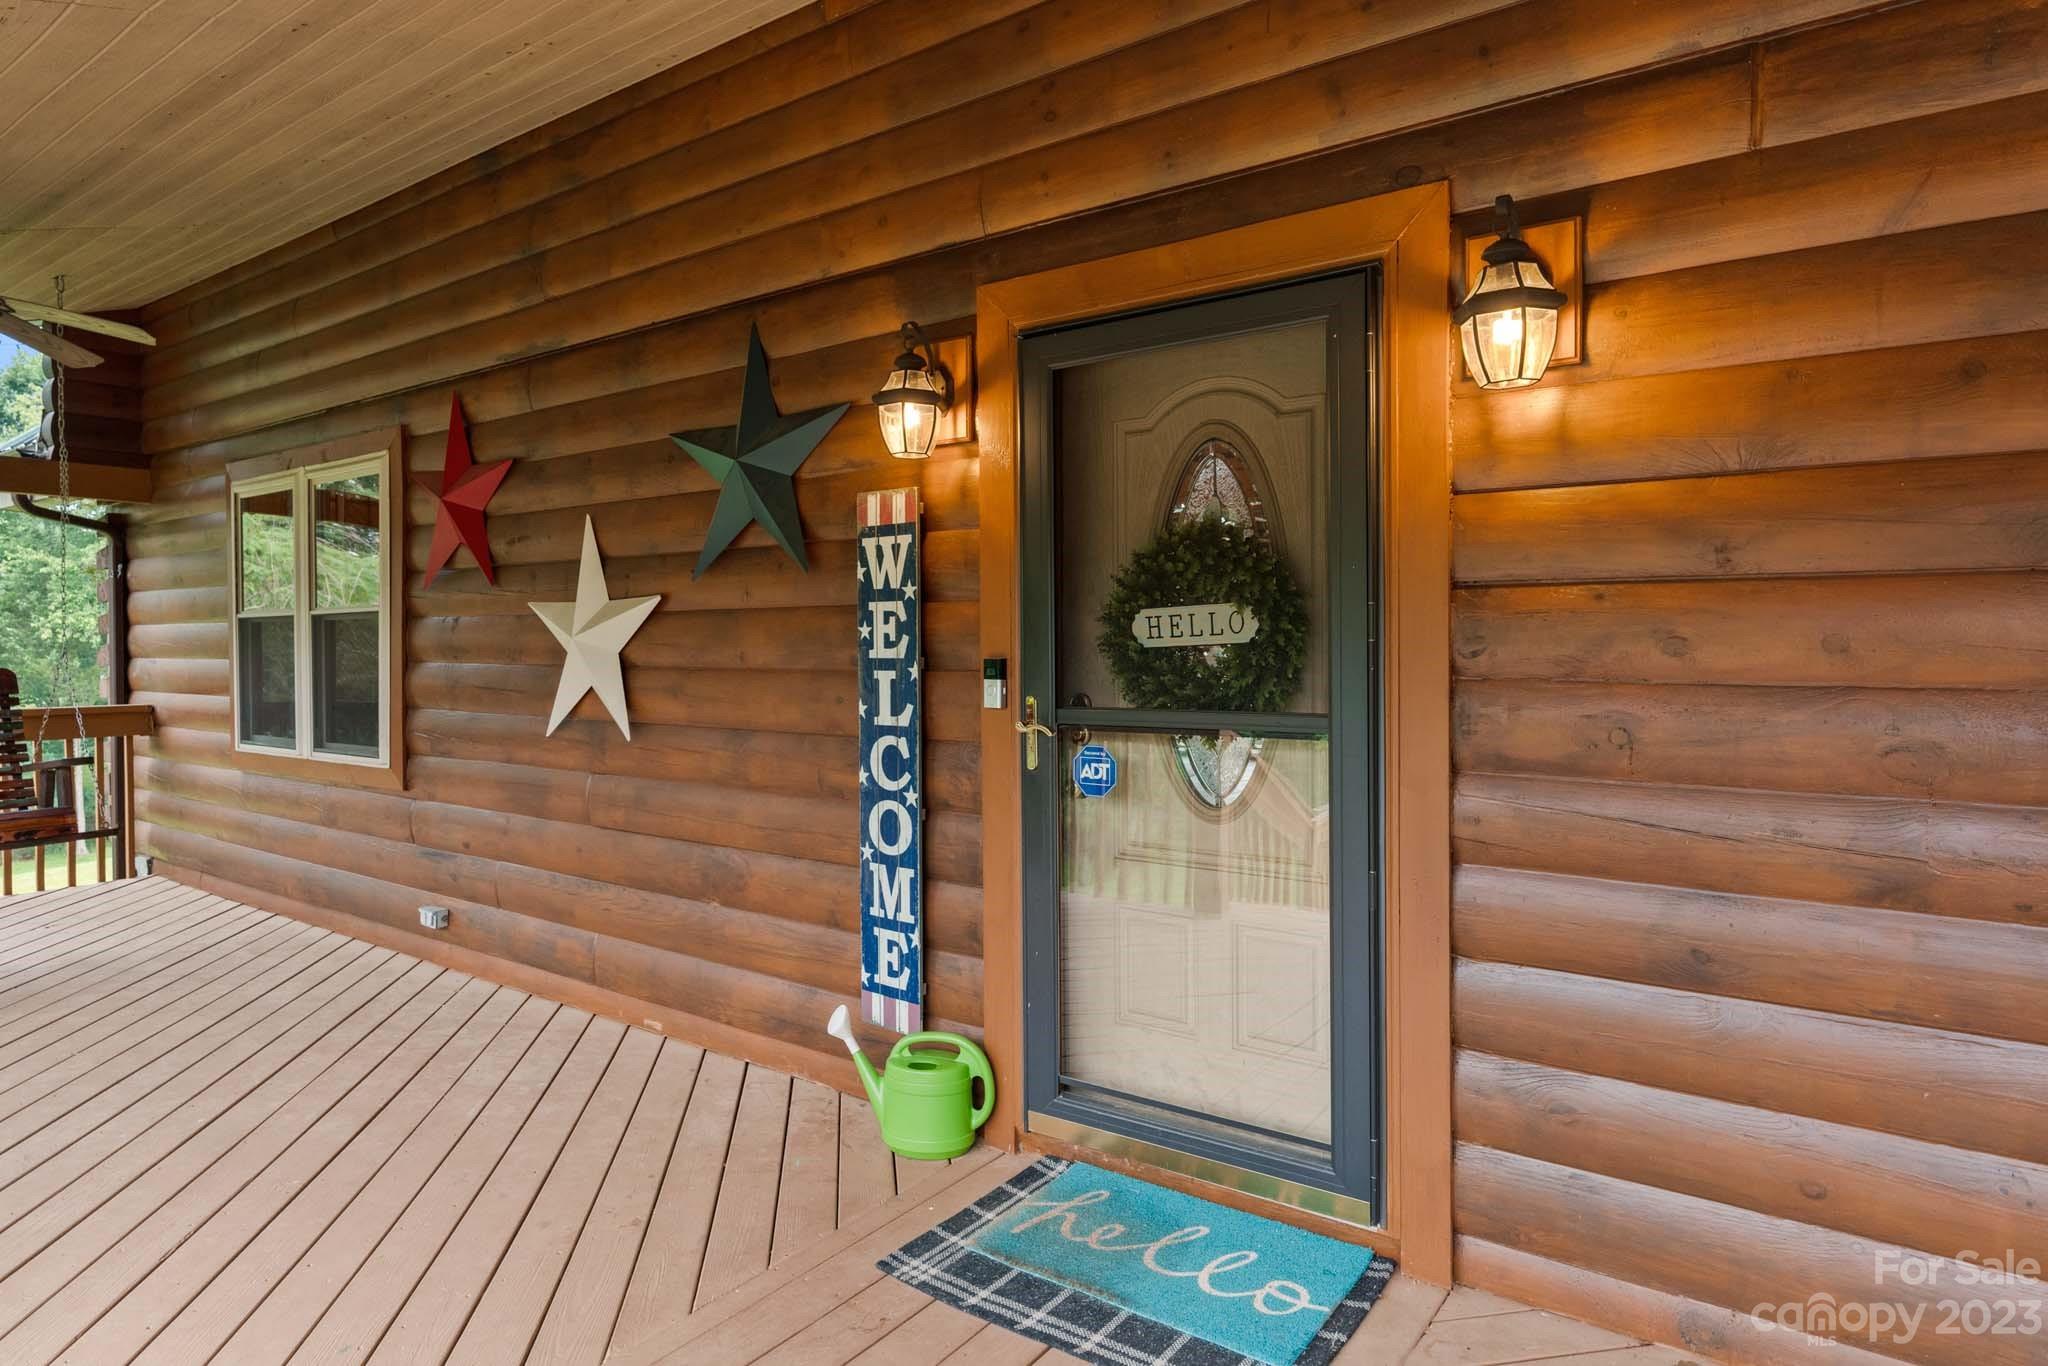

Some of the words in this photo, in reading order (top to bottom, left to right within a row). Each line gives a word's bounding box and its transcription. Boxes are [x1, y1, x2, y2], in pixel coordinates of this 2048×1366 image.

[1145, 610, 1245, 639] HELLO
[862, 535, 915, 991] WELCOME
[1080, 763, 1110, 780] ADT
[1010, 1190, 1334, 1315] hello
